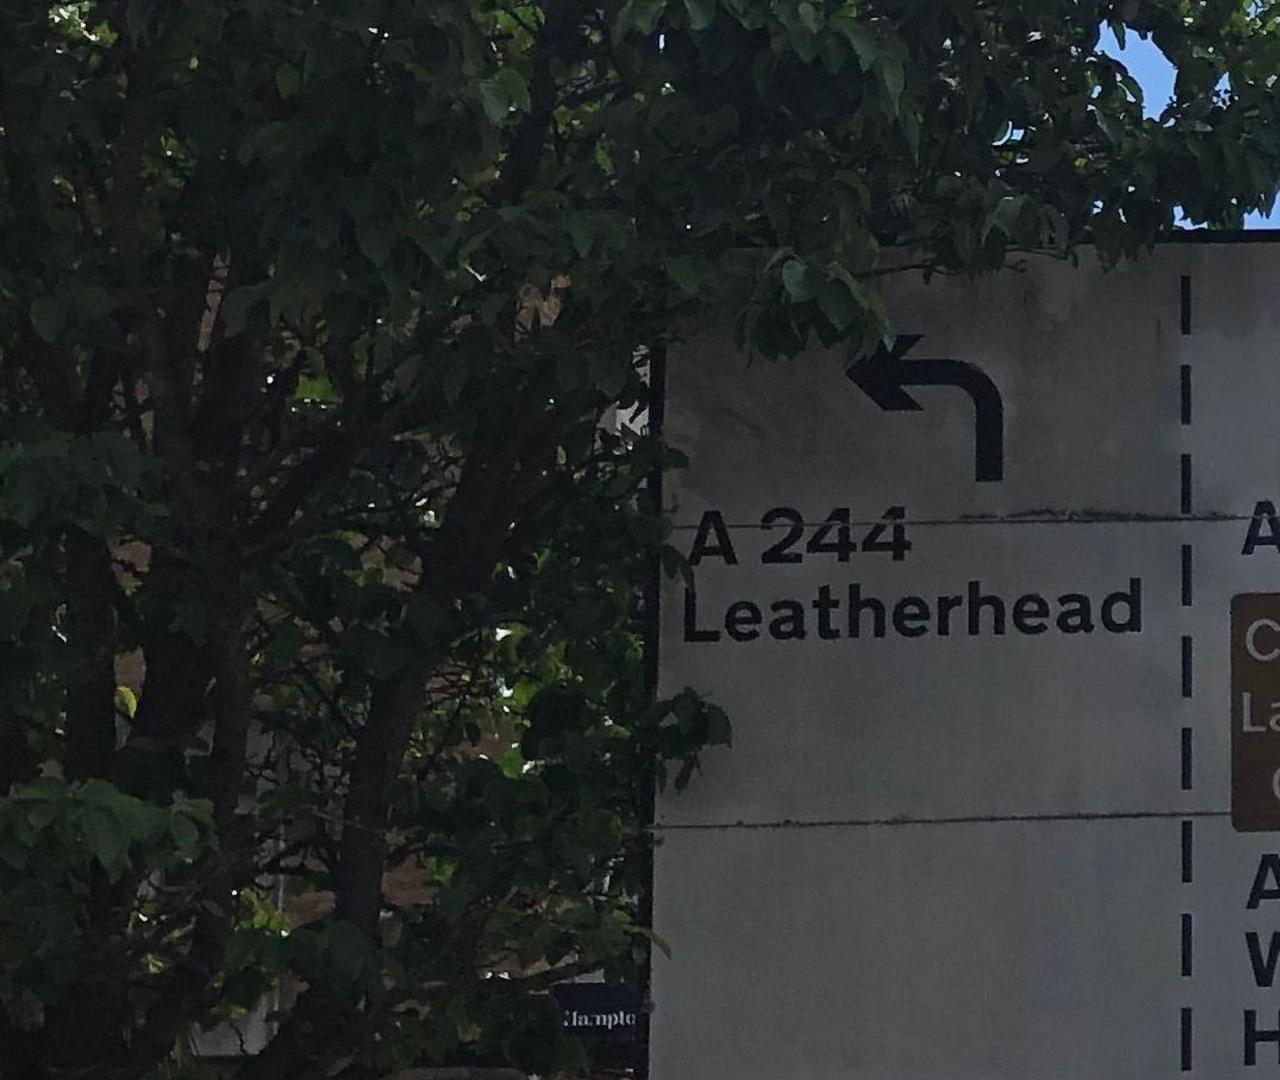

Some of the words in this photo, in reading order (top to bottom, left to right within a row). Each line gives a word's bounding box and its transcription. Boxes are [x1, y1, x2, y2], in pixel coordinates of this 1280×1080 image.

[689, 510, 738, 566] A
[761, 506, 912, 564] 244
[684, 578, 1142, 643] Leatherhead
